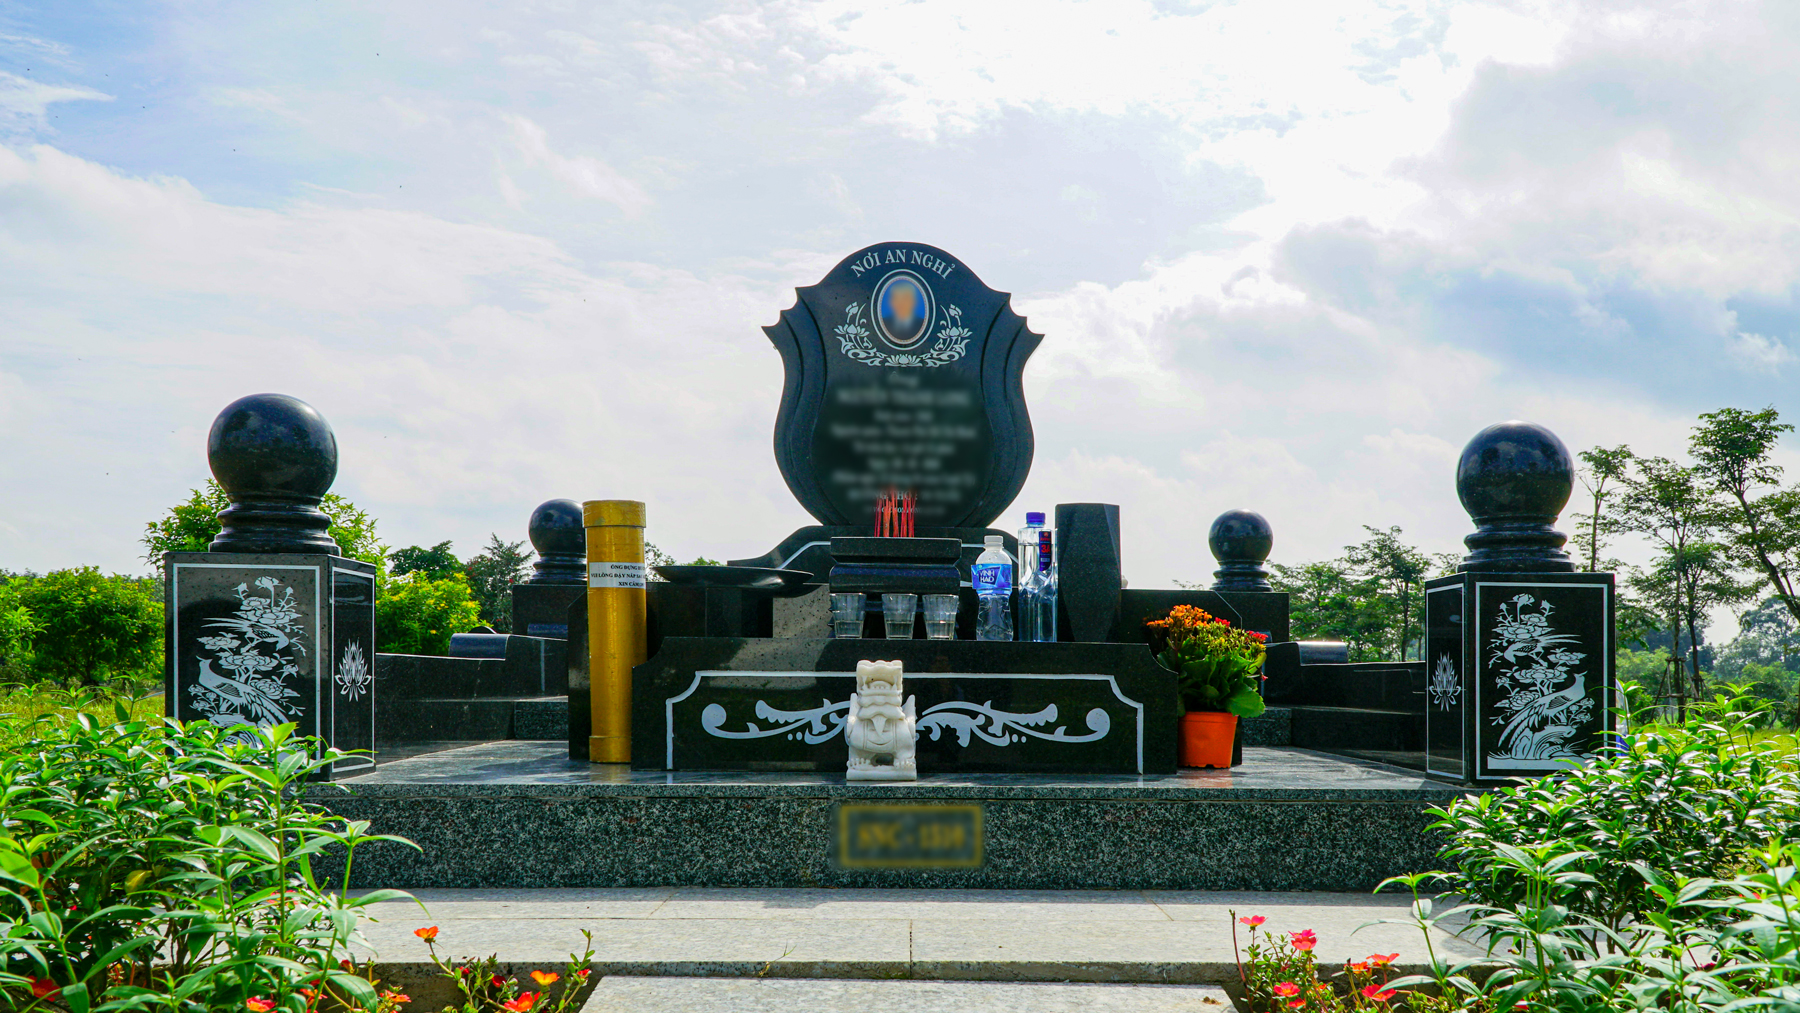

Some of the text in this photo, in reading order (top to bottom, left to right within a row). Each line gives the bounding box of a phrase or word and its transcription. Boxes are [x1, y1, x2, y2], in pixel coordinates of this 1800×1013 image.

[850, 249, 956, 280] NƠI AN NGHỈ
